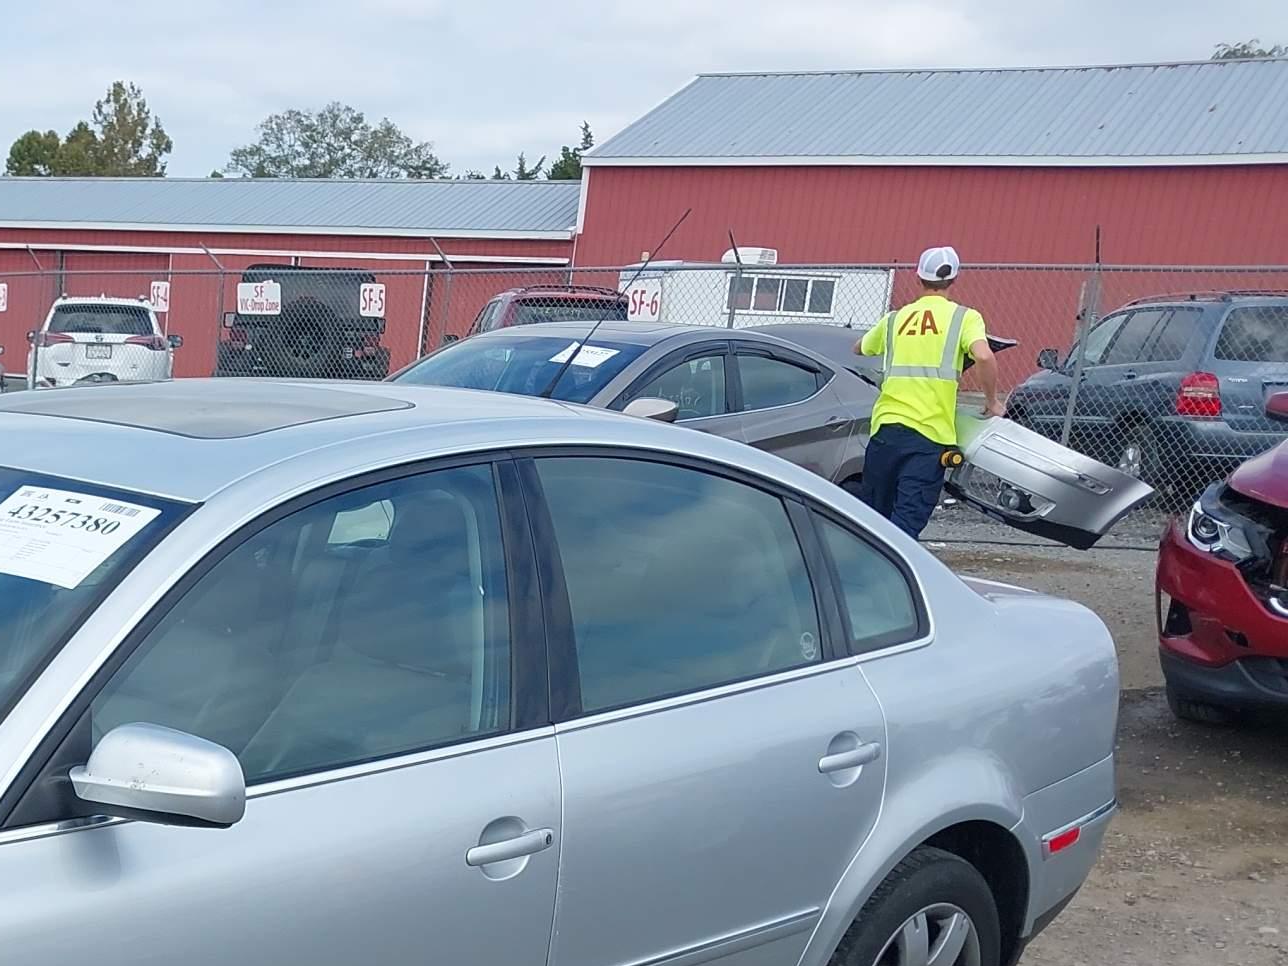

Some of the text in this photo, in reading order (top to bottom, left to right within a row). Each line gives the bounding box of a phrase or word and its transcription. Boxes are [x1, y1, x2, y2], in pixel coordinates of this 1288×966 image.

[254, 285, 265, 298] SF
[362, 287, 384, 312] SF-5
[629, 289, 659, 317] SF-6
[265, 298, 280, 312] Zone
[8, 503, 121, 536] 43257380
